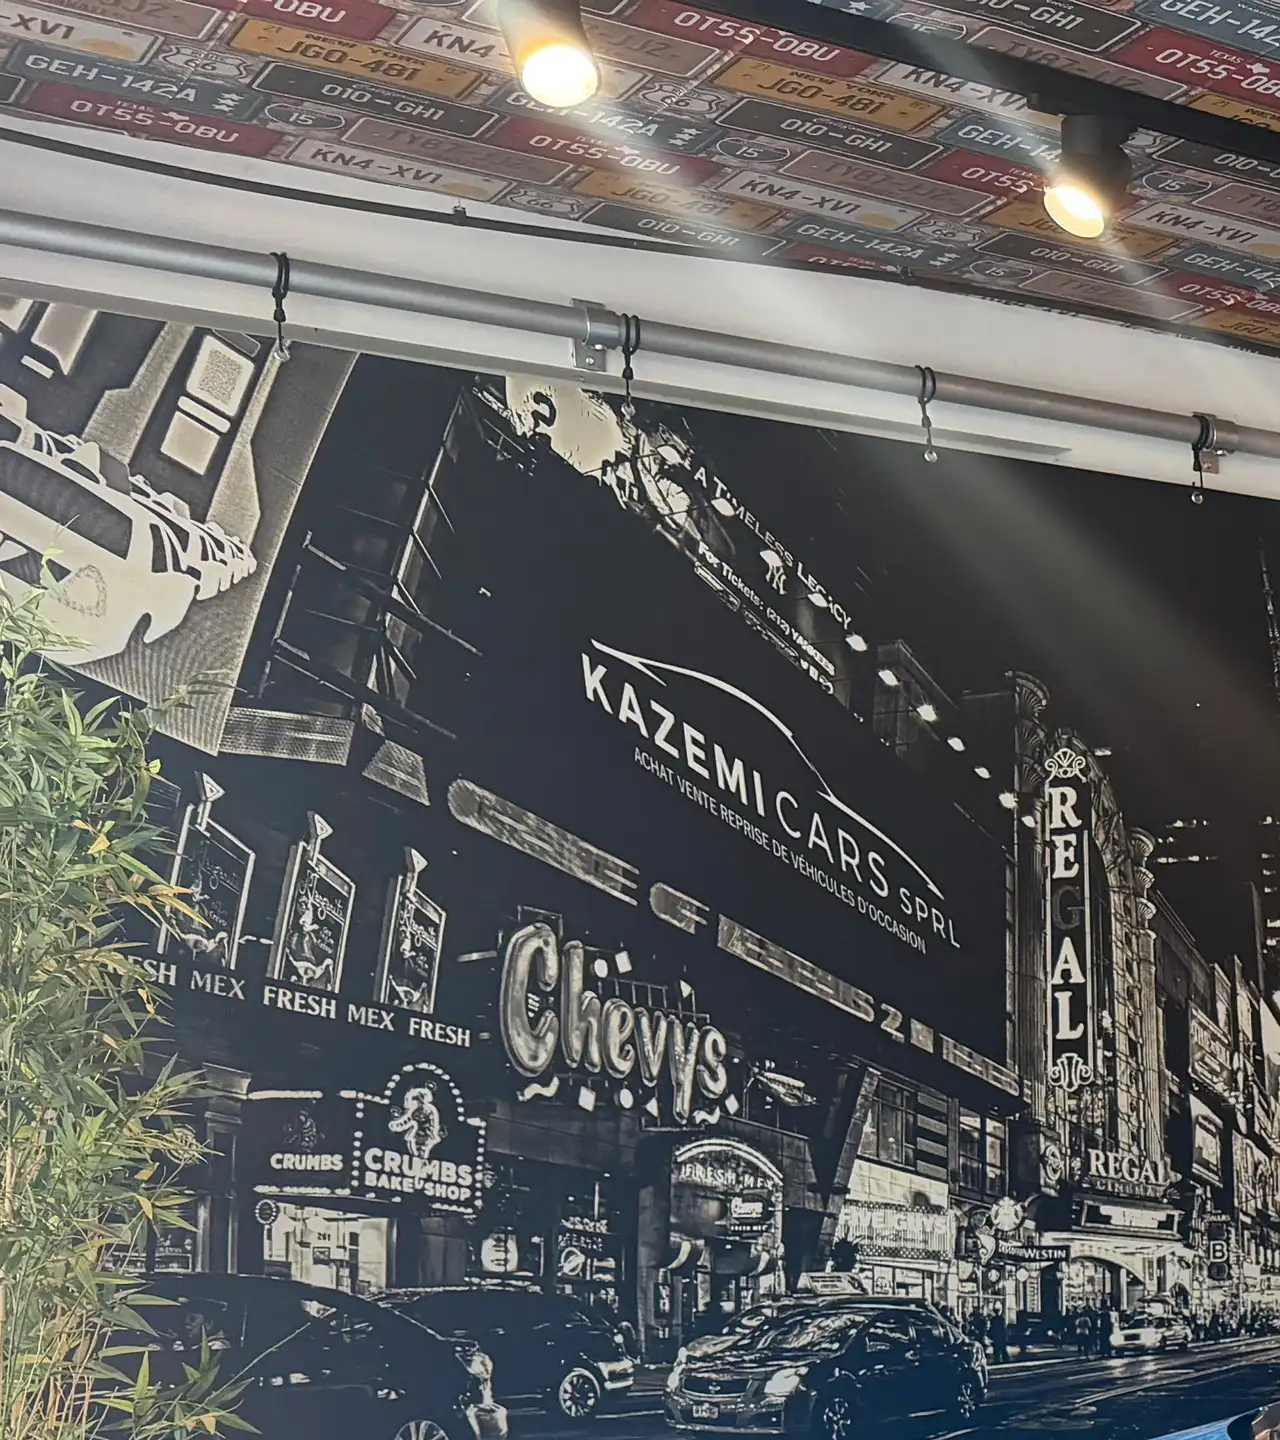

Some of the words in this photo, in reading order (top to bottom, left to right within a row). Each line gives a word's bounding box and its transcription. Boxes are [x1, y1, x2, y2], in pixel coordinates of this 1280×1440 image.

[1209, 49, 1244, 65] TEXAS
[634, 746, 675, 787] ACHAT
[677, 773, 719, 816] VENTE
[719, 804, 771, 852] REPRISE
[771, 837, 790, 865] DE
[788, 852, 858, 911] VÉHICULES
[857, 898, 929, 956] D'OCCASION
[899, 886, 961, 949] SPRL
[1048, 784, 1086, 1042] REGAL
[190, 969, 246, 1001] MEX
[263, 984, 337, 1021] FRESH
[347, 1003, 395, 1033] MEX
[407, 1016, 472, 1049] FRESH
[270, 1152, 344, 1173] CRUMBS
[364, 1147, 473, 1187] CRUMBS
